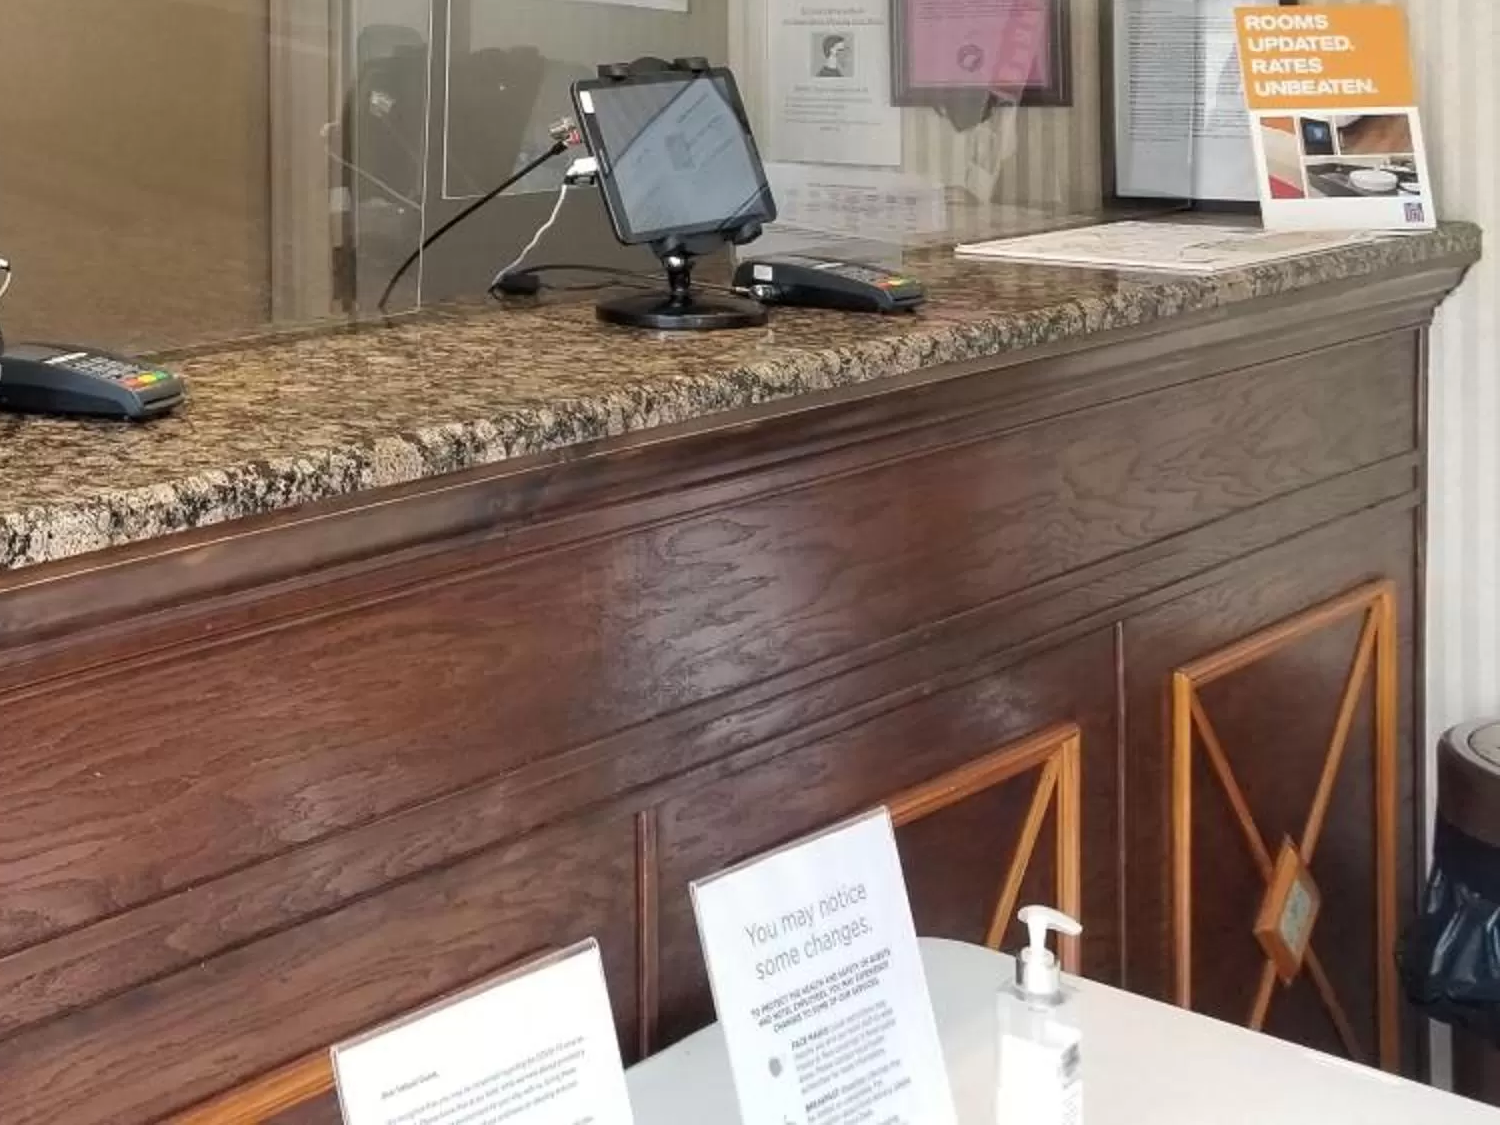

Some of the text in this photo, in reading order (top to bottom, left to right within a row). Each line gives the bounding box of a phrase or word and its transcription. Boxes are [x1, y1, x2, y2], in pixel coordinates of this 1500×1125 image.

[1244, 14, 1329, 31] ROOMS
[1248, 35, 1355, 52] UPDATED.
[1251, 57, 1323, 74] RATES
[1254, 78, 1380, 97] UNBEATEN.
[744, 882, 867, 948] You may notice
[755, 916, 873, 980] some changes.
